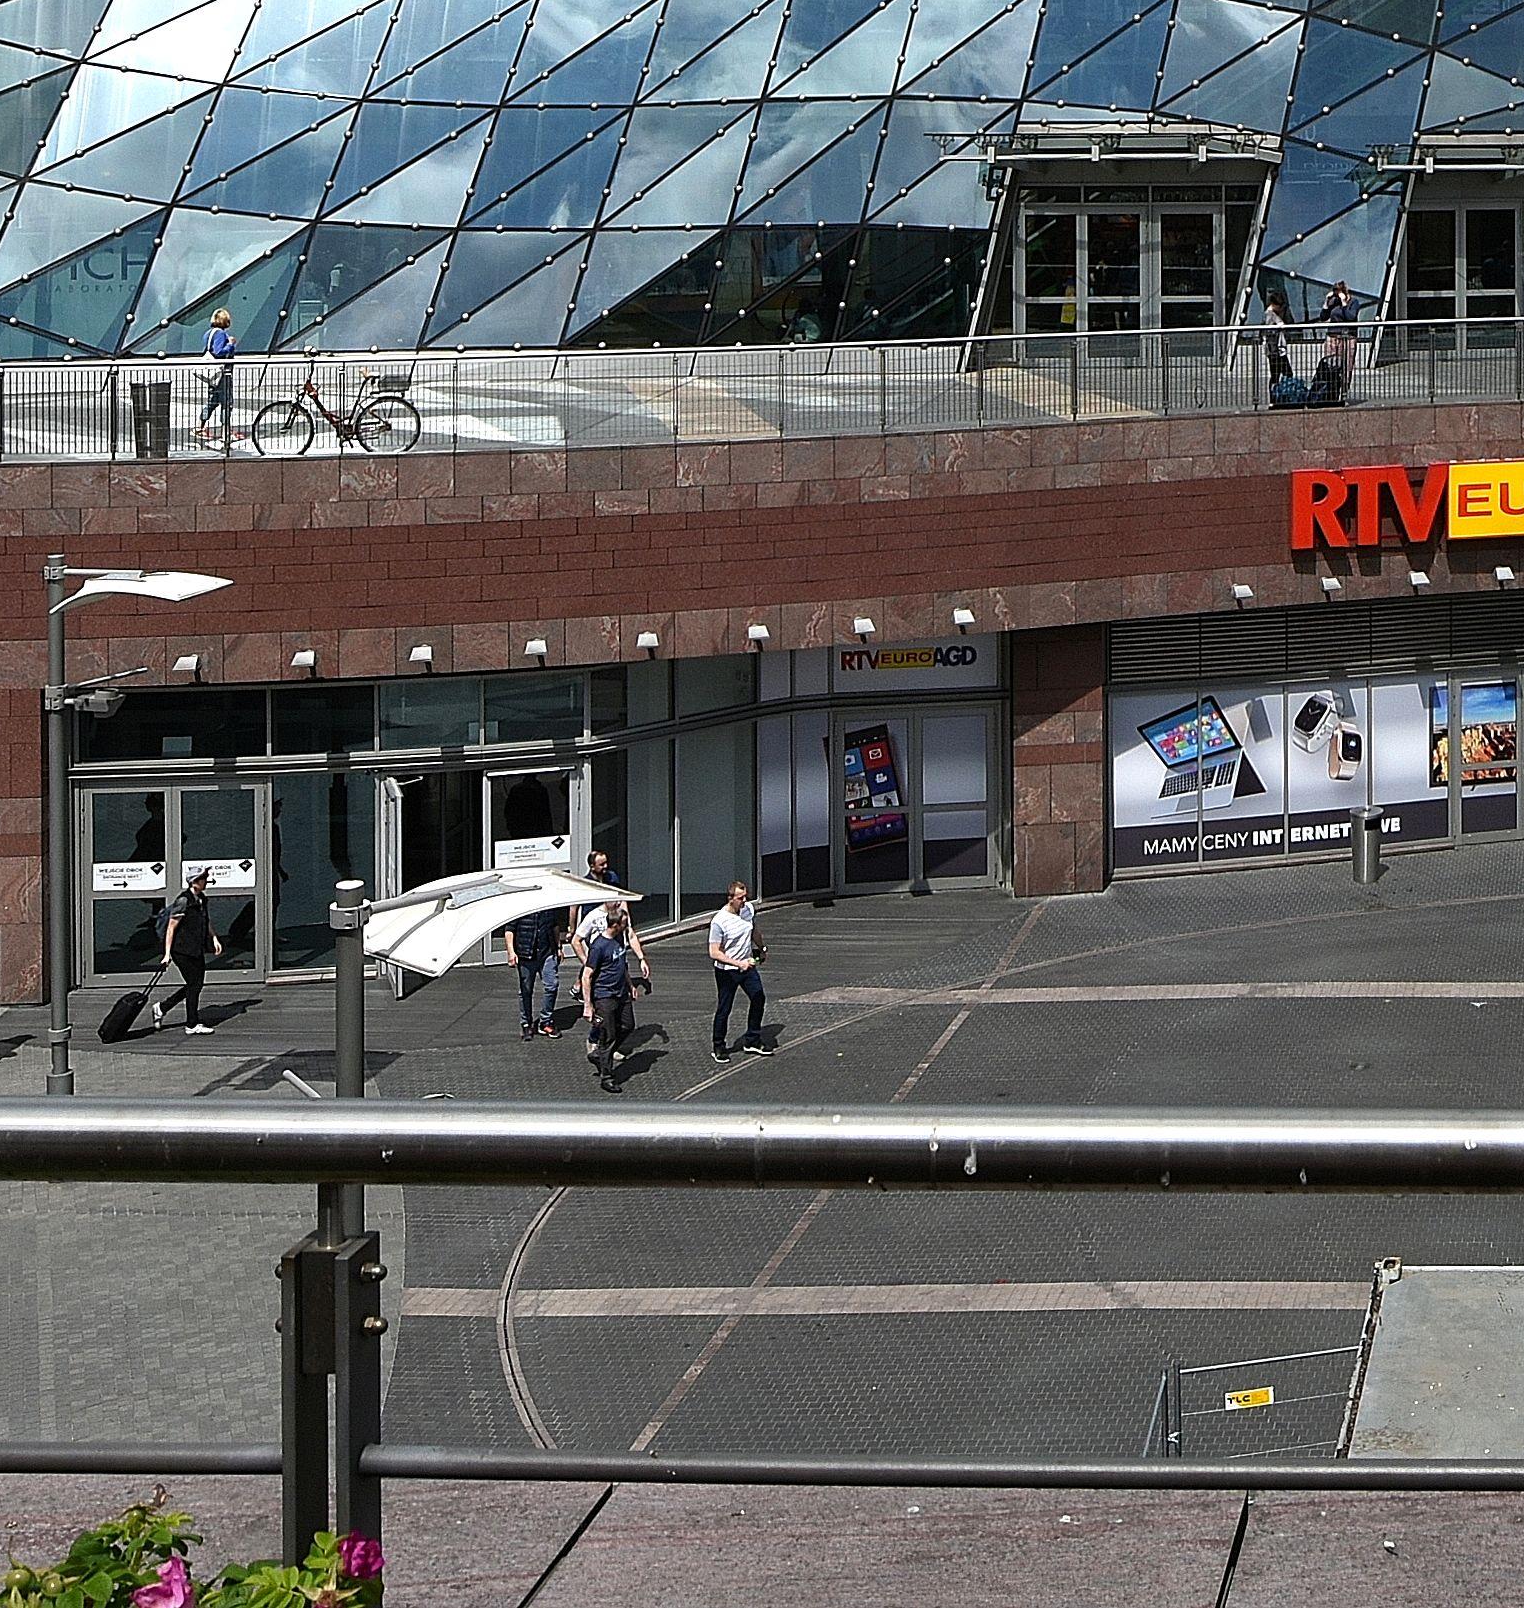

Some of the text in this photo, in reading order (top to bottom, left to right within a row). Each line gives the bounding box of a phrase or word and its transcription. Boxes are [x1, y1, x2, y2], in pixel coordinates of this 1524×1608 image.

[1291, 463, 1448, 550] RTV
[840, 645, 977, 672] RTV EURO AGD
[1143, 837, 1198, 856] MAMY
[1201, 832, 1249, 852] CENY
[1227, 1395, 1251, 1404] TLC
